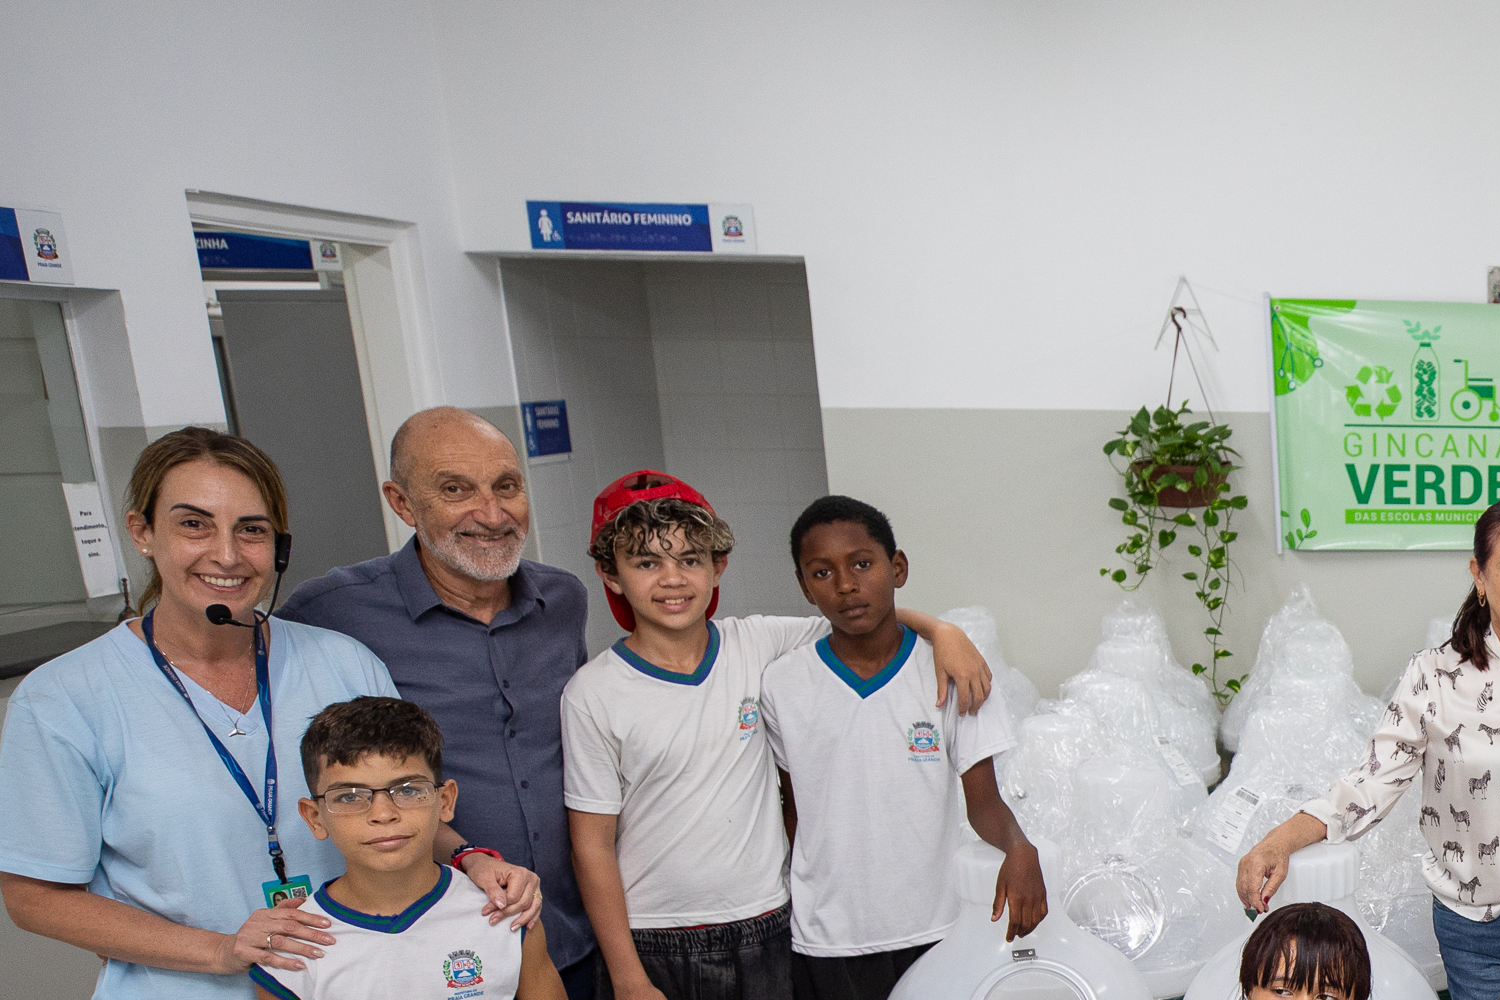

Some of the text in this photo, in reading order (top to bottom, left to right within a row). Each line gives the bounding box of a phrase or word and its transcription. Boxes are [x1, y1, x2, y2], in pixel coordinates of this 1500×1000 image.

[566, 210, 692, 226] SANITÁRIO FEMININO
[1355, 512, 1378, 521] DAS
[1380, 512, 1432, 522] ESCOLAS
[73, 523, 108, 531] tendimento,
